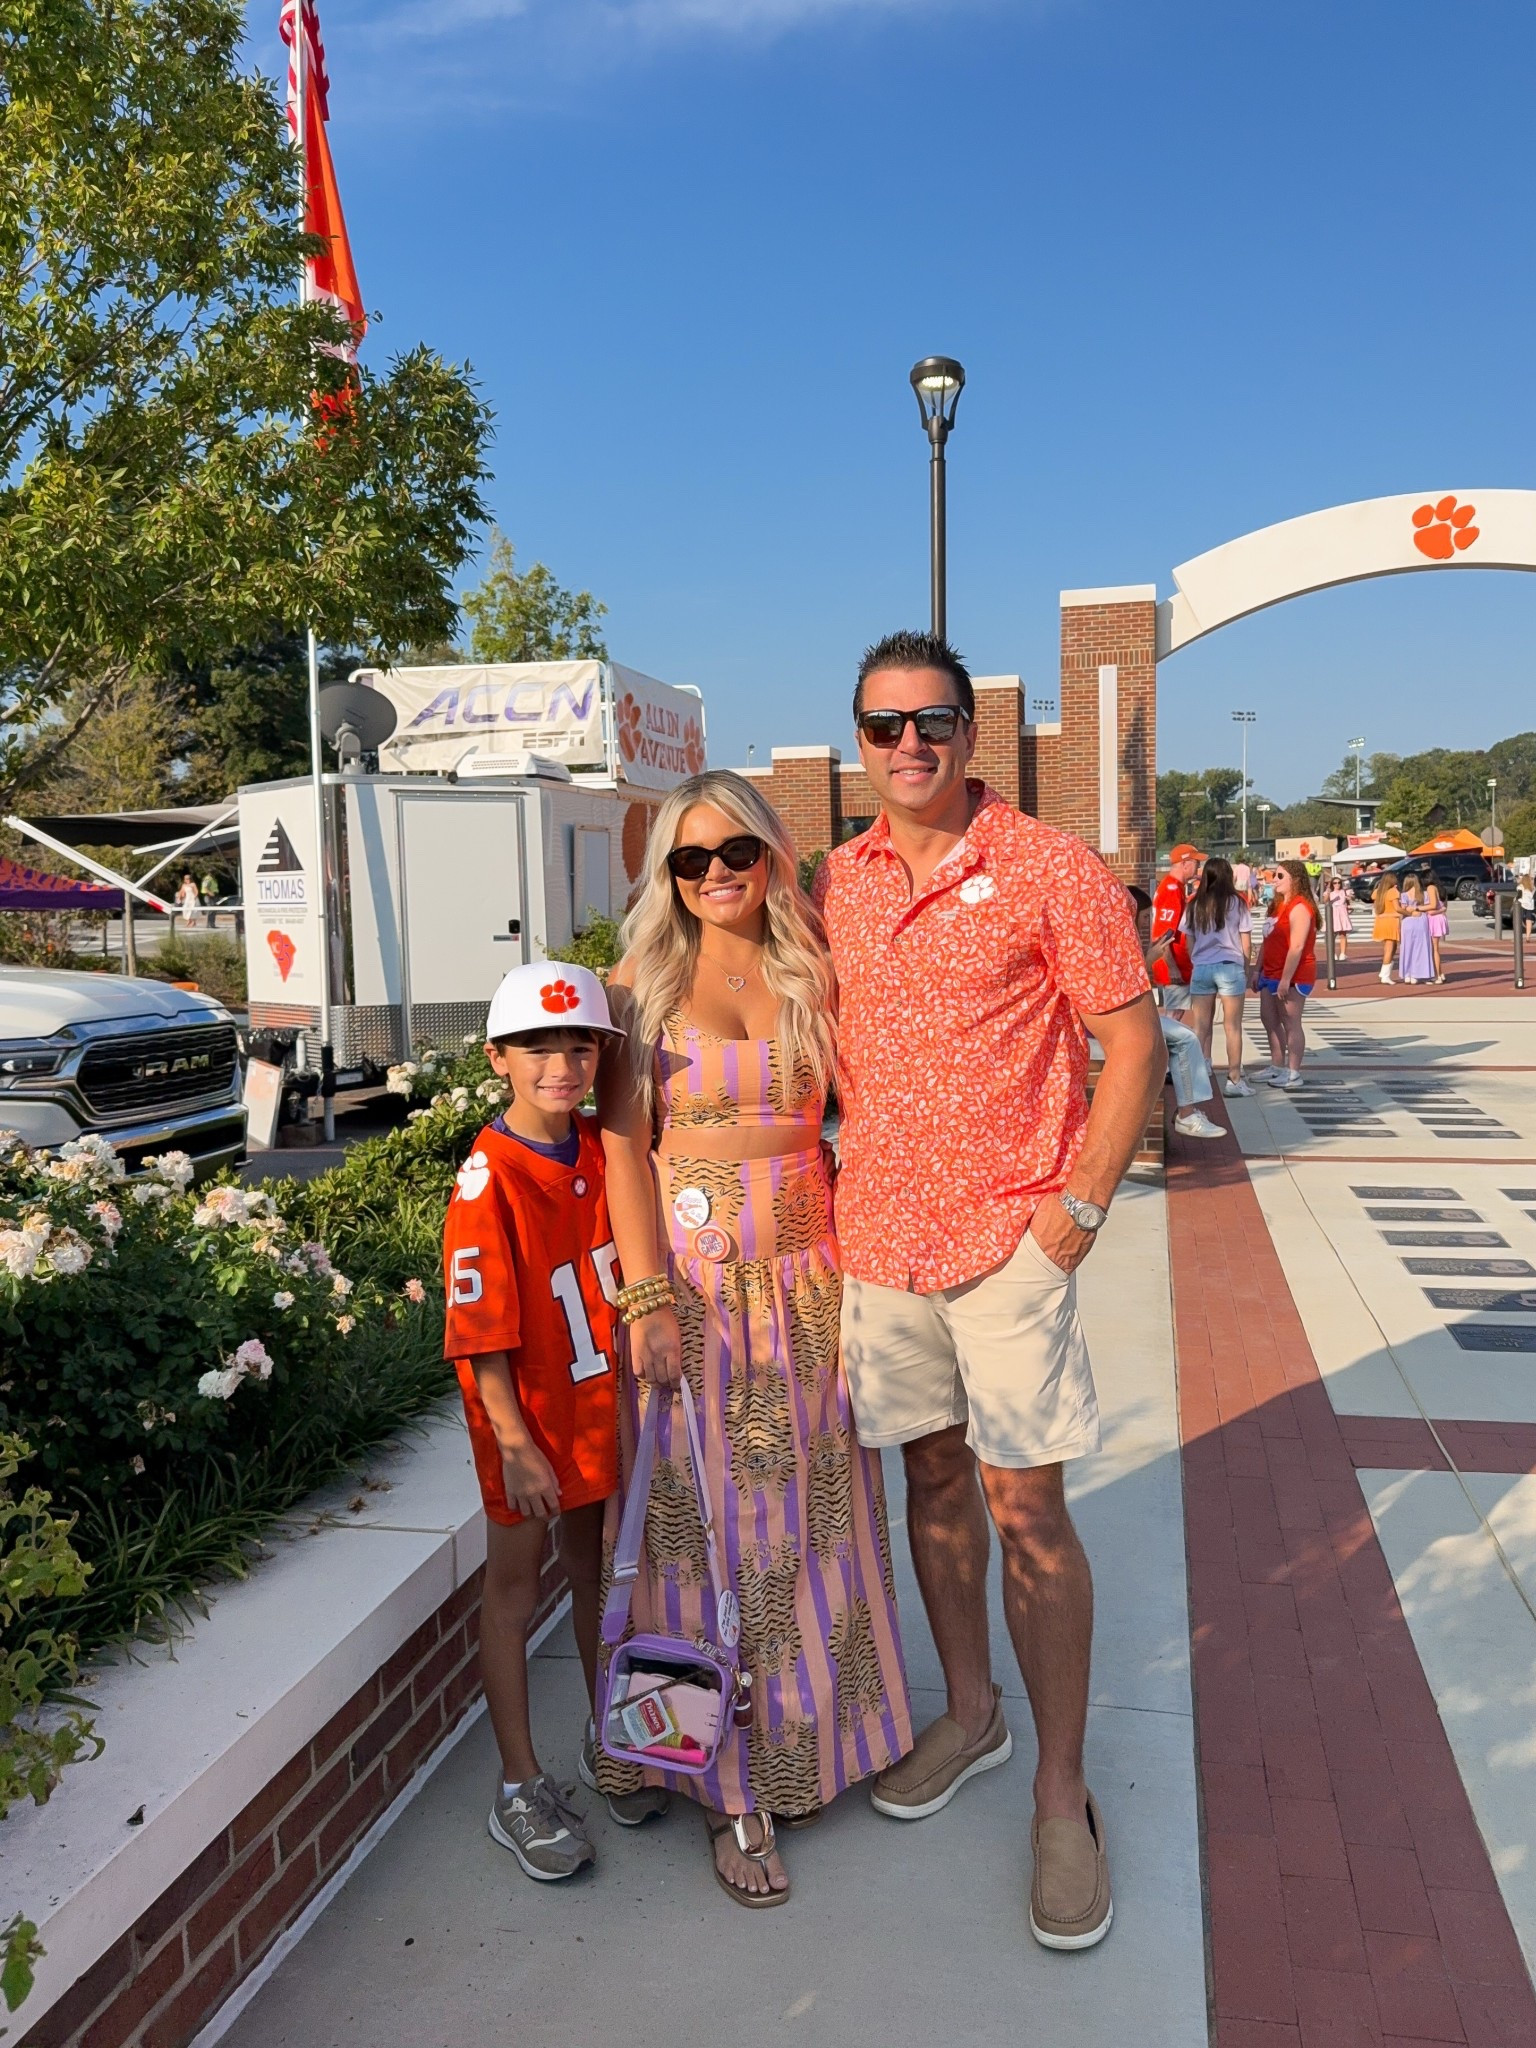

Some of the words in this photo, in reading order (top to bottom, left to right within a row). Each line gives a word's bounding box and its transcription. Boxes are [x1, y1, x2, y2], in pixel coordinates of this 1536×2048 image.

[404, 678, 596, 730] ACCN
[645, 703, 666, 735] ALL
[666, 710, 680, 739] IN
[522, 729, 585, 749] ESPN
[641, 737, 686, 774] AVENUE
[257, 878, 305, 900] THOMAS
[1159, 908, 1175, 922] 37
[145, 1053, 210, 1077] RAM
[701, 1242, 723, 1256] GAMES
